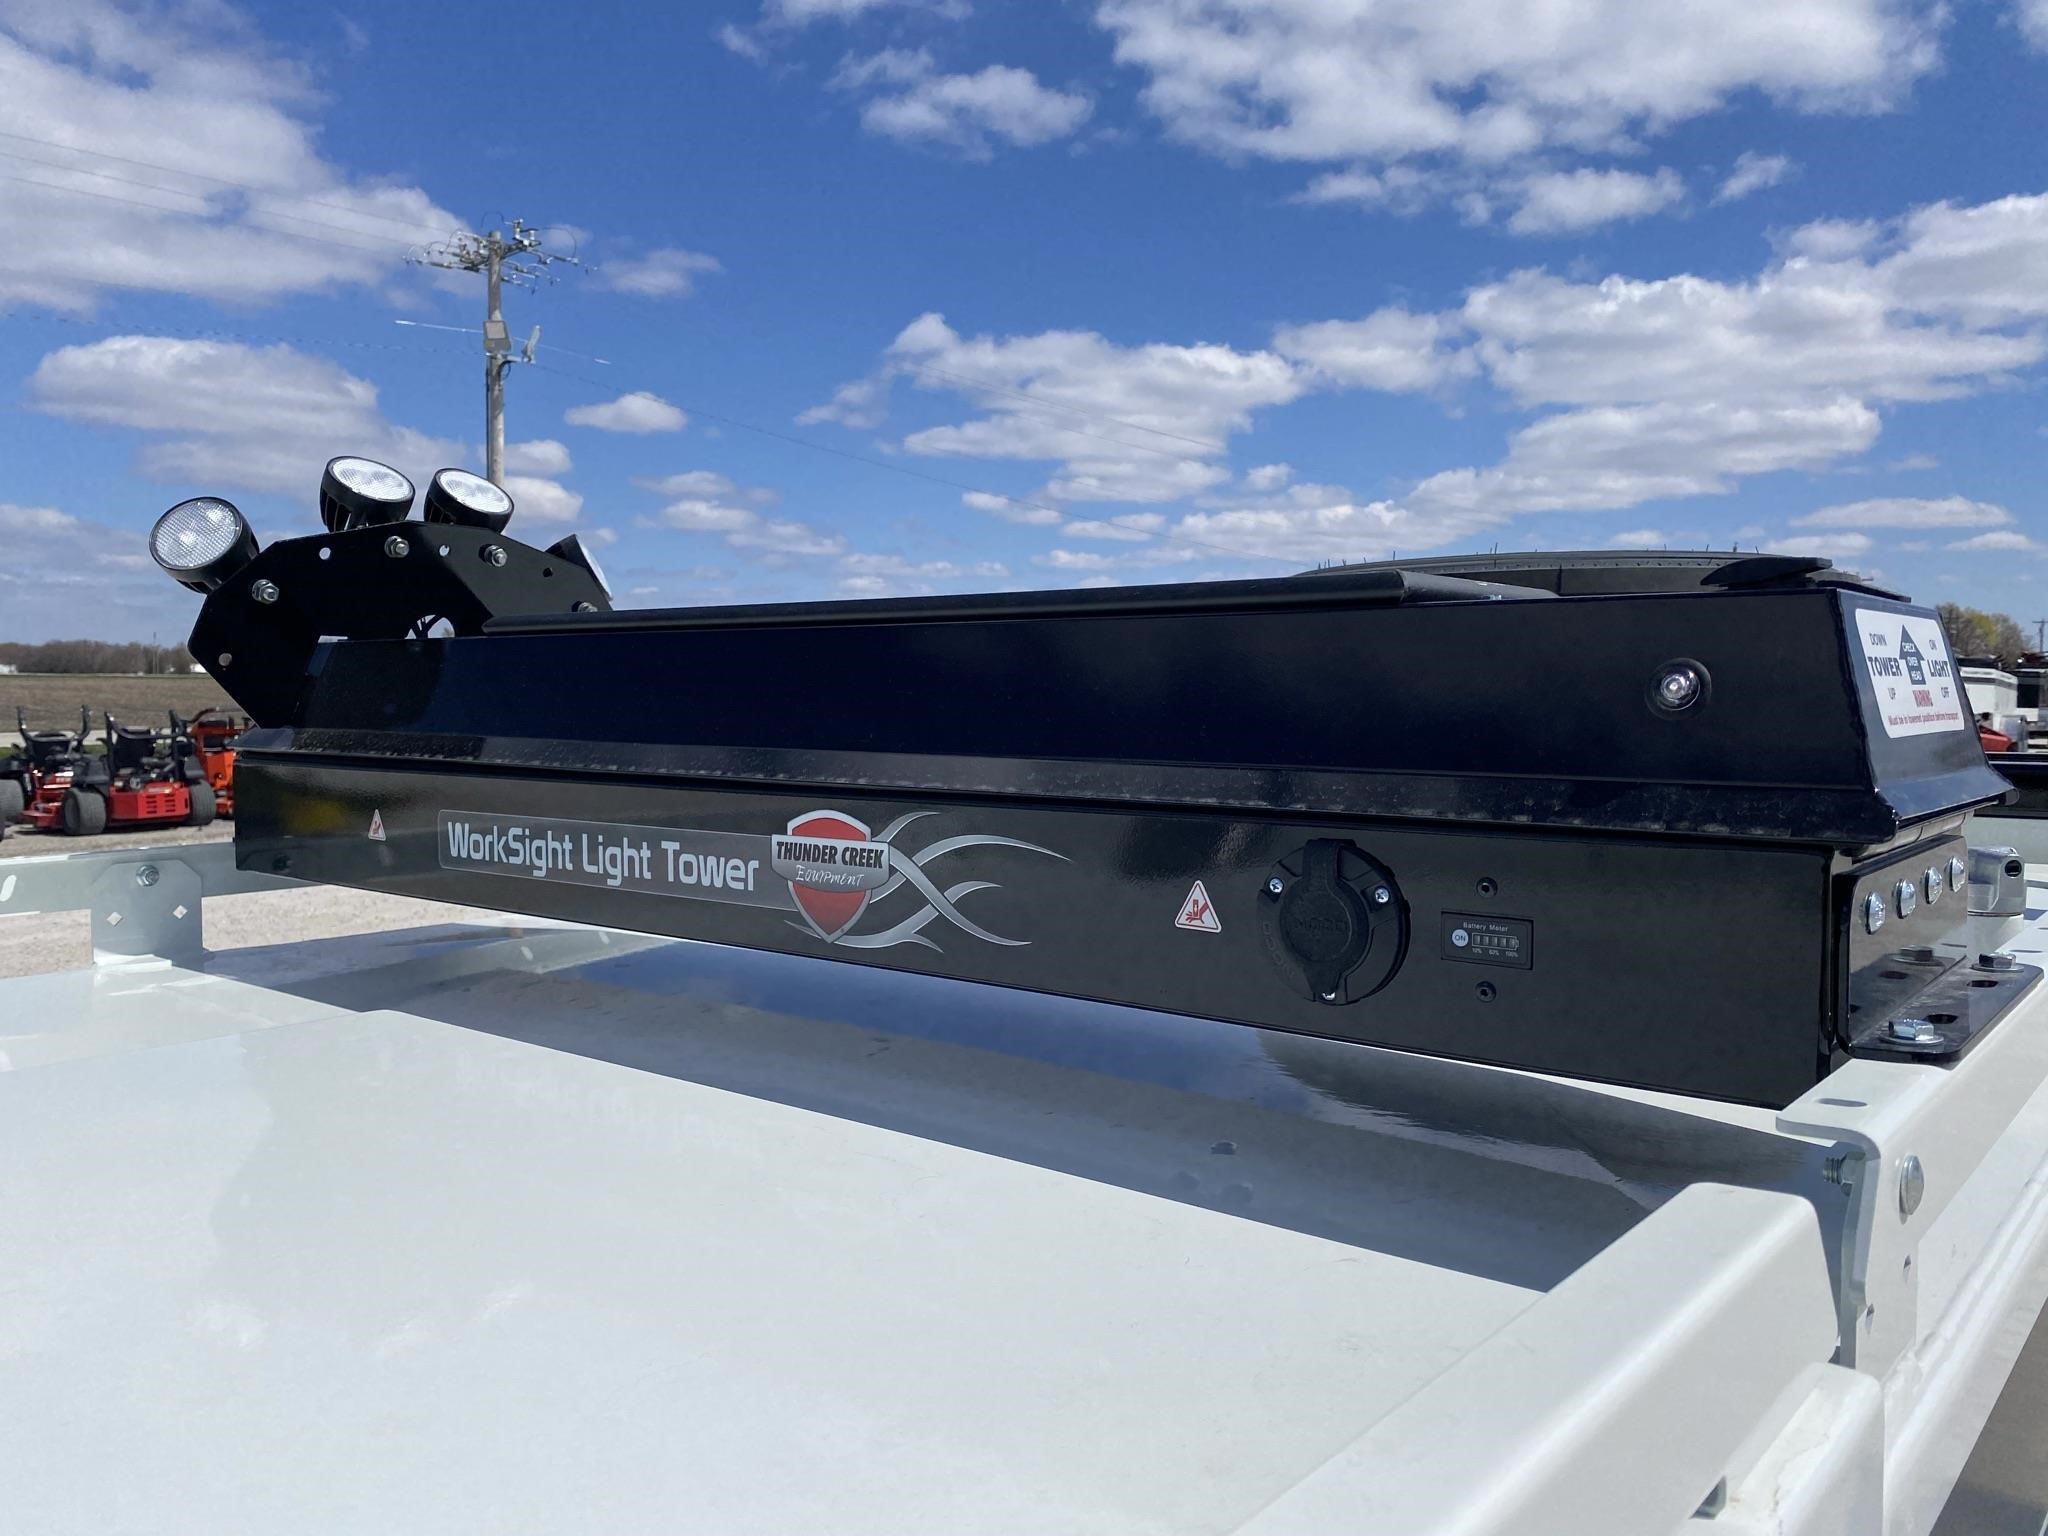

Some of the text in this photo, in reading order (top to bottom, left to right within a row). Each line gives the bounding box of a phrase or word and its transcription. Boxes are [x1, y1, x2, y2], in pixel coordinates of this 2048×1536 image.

[1869, 633, 1888, 646] DOWN
[1929, 639, 1937, 650] ON
[1902, 642, 1917, 652] CHECK
[1867, 656, 1902, 677] TOWER
[1927, 660, 1952, 677] LIGHT
[1888, 688, 1896, 700] UP
[1940, 687, 1950, 698] OFF
[447, 821, 759, 891] WorkSight Light Tower
[776, 841, 885, 869] THUNDER CREEK
[1463, 922, 1508, 932] Battery Meter
[1454, 934, 1466, 942] ON
